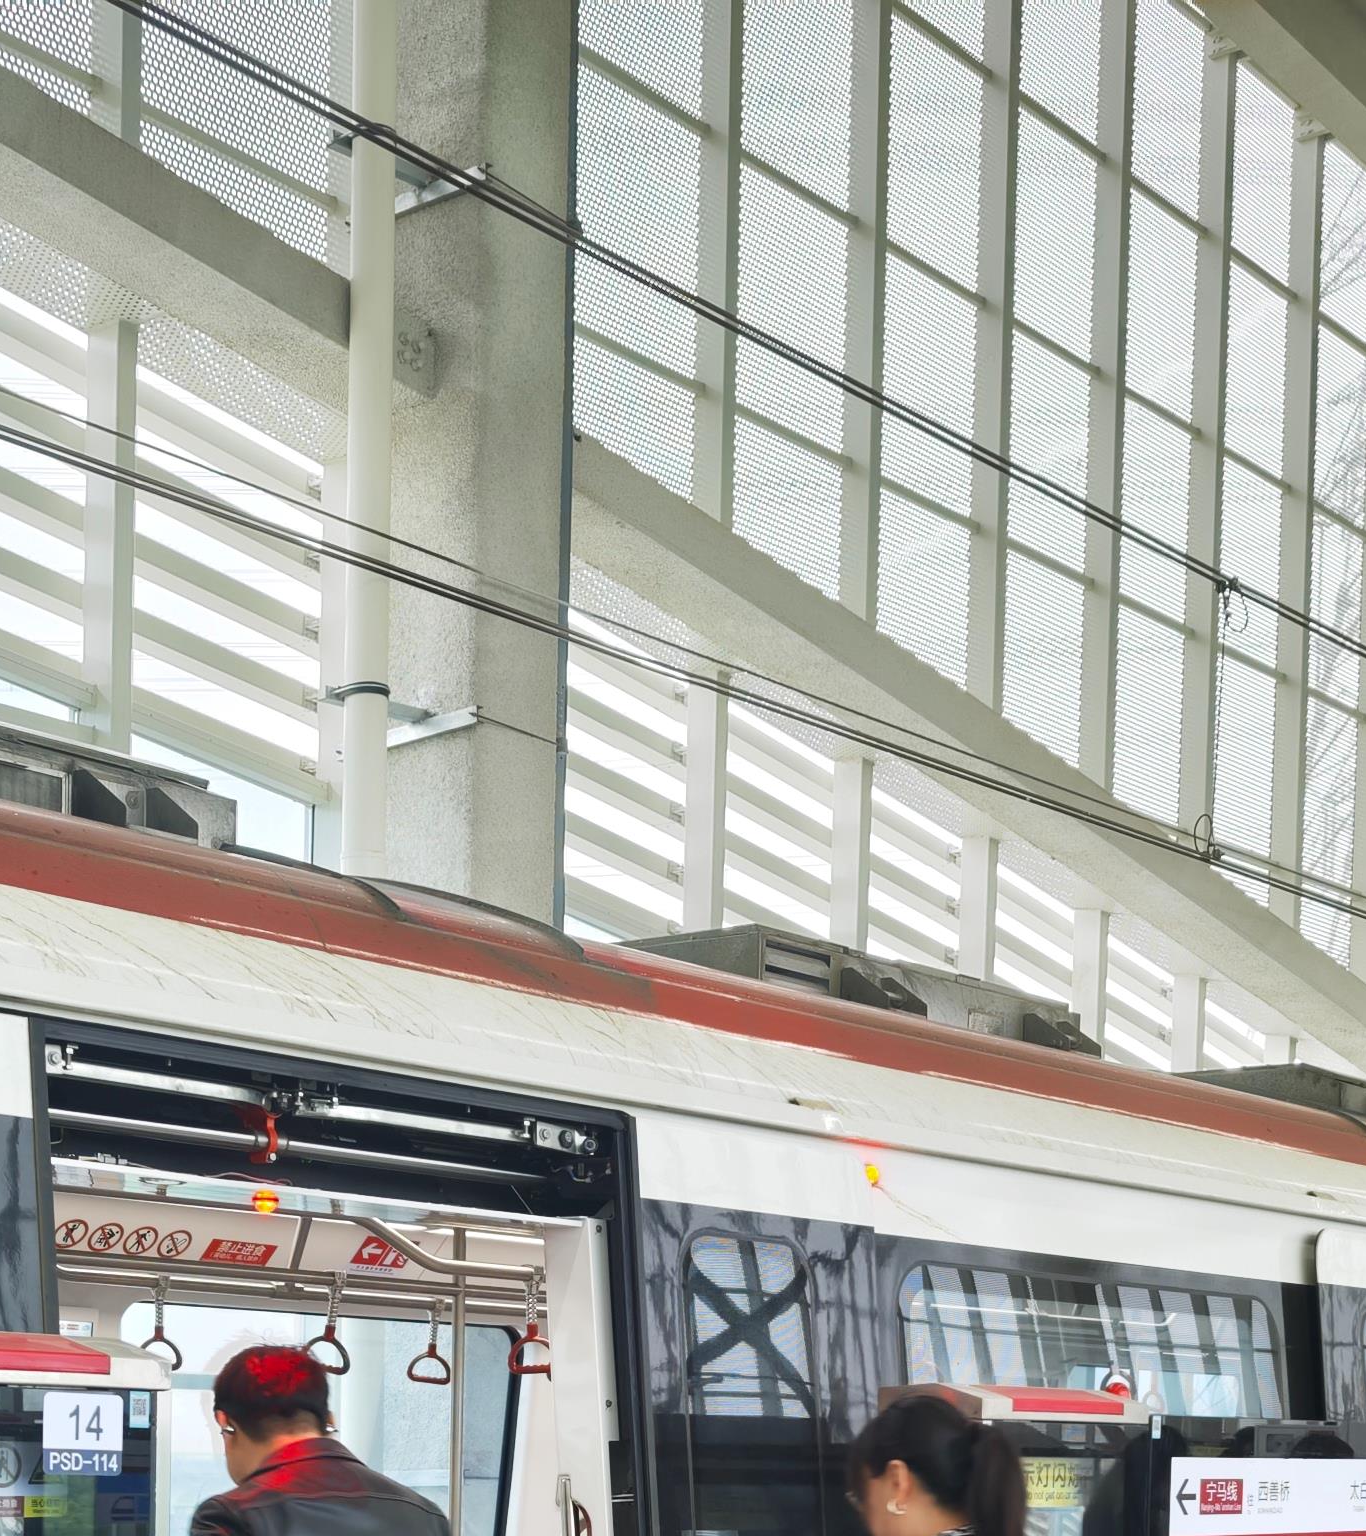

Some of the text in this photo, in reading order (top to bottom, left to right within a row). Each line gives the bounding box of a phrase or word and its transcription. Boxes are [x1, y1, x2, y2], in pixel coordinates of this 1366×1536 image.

[69, 1404, 103, 1441] 14
[49, 1452, 118, 1472] PSD-114
[1206, 1481, 1237, 1501] 宁马线
[1258, 1481, 1290, 1501] 西善桥
